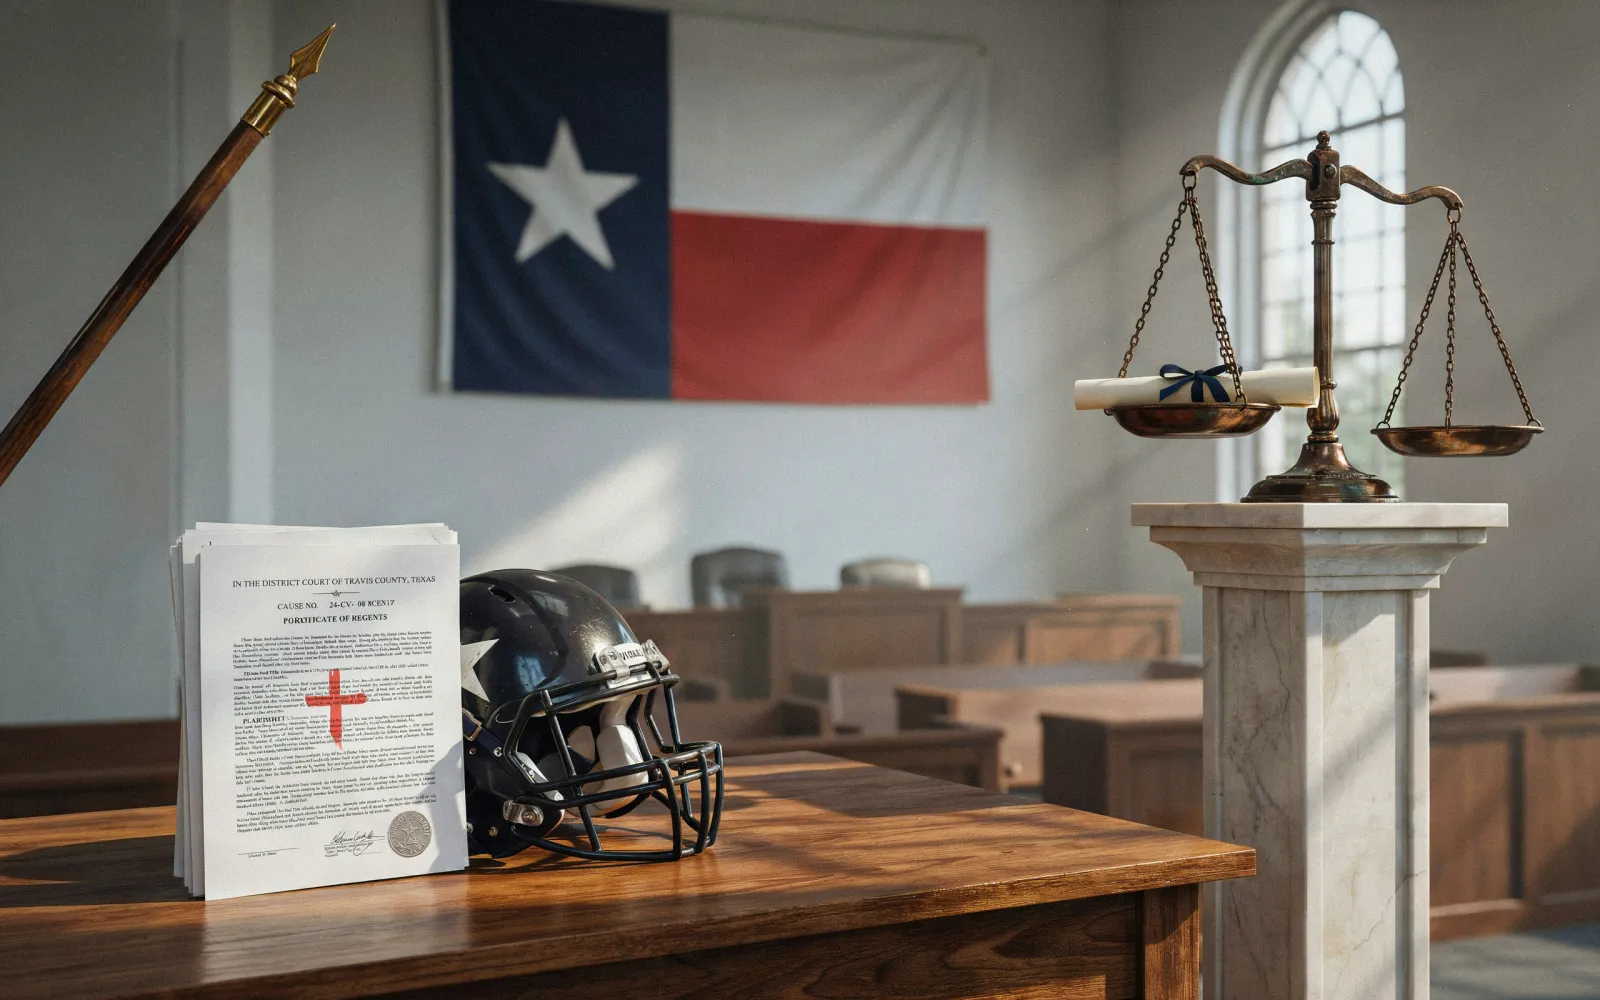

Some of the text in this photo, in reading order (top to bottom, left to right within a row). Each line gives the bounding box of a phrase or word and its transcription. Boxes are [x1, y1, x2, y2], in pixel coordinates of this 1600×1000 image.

[232, 575, 436, 588] IN THE DISTRICT COURT OF TRAVIS COUNTY, TEXAS
[277, 602, 304, 610] CAUSE
[339, 614, 350, 622] OF
[351, 613, 388, 621] REGENTS
